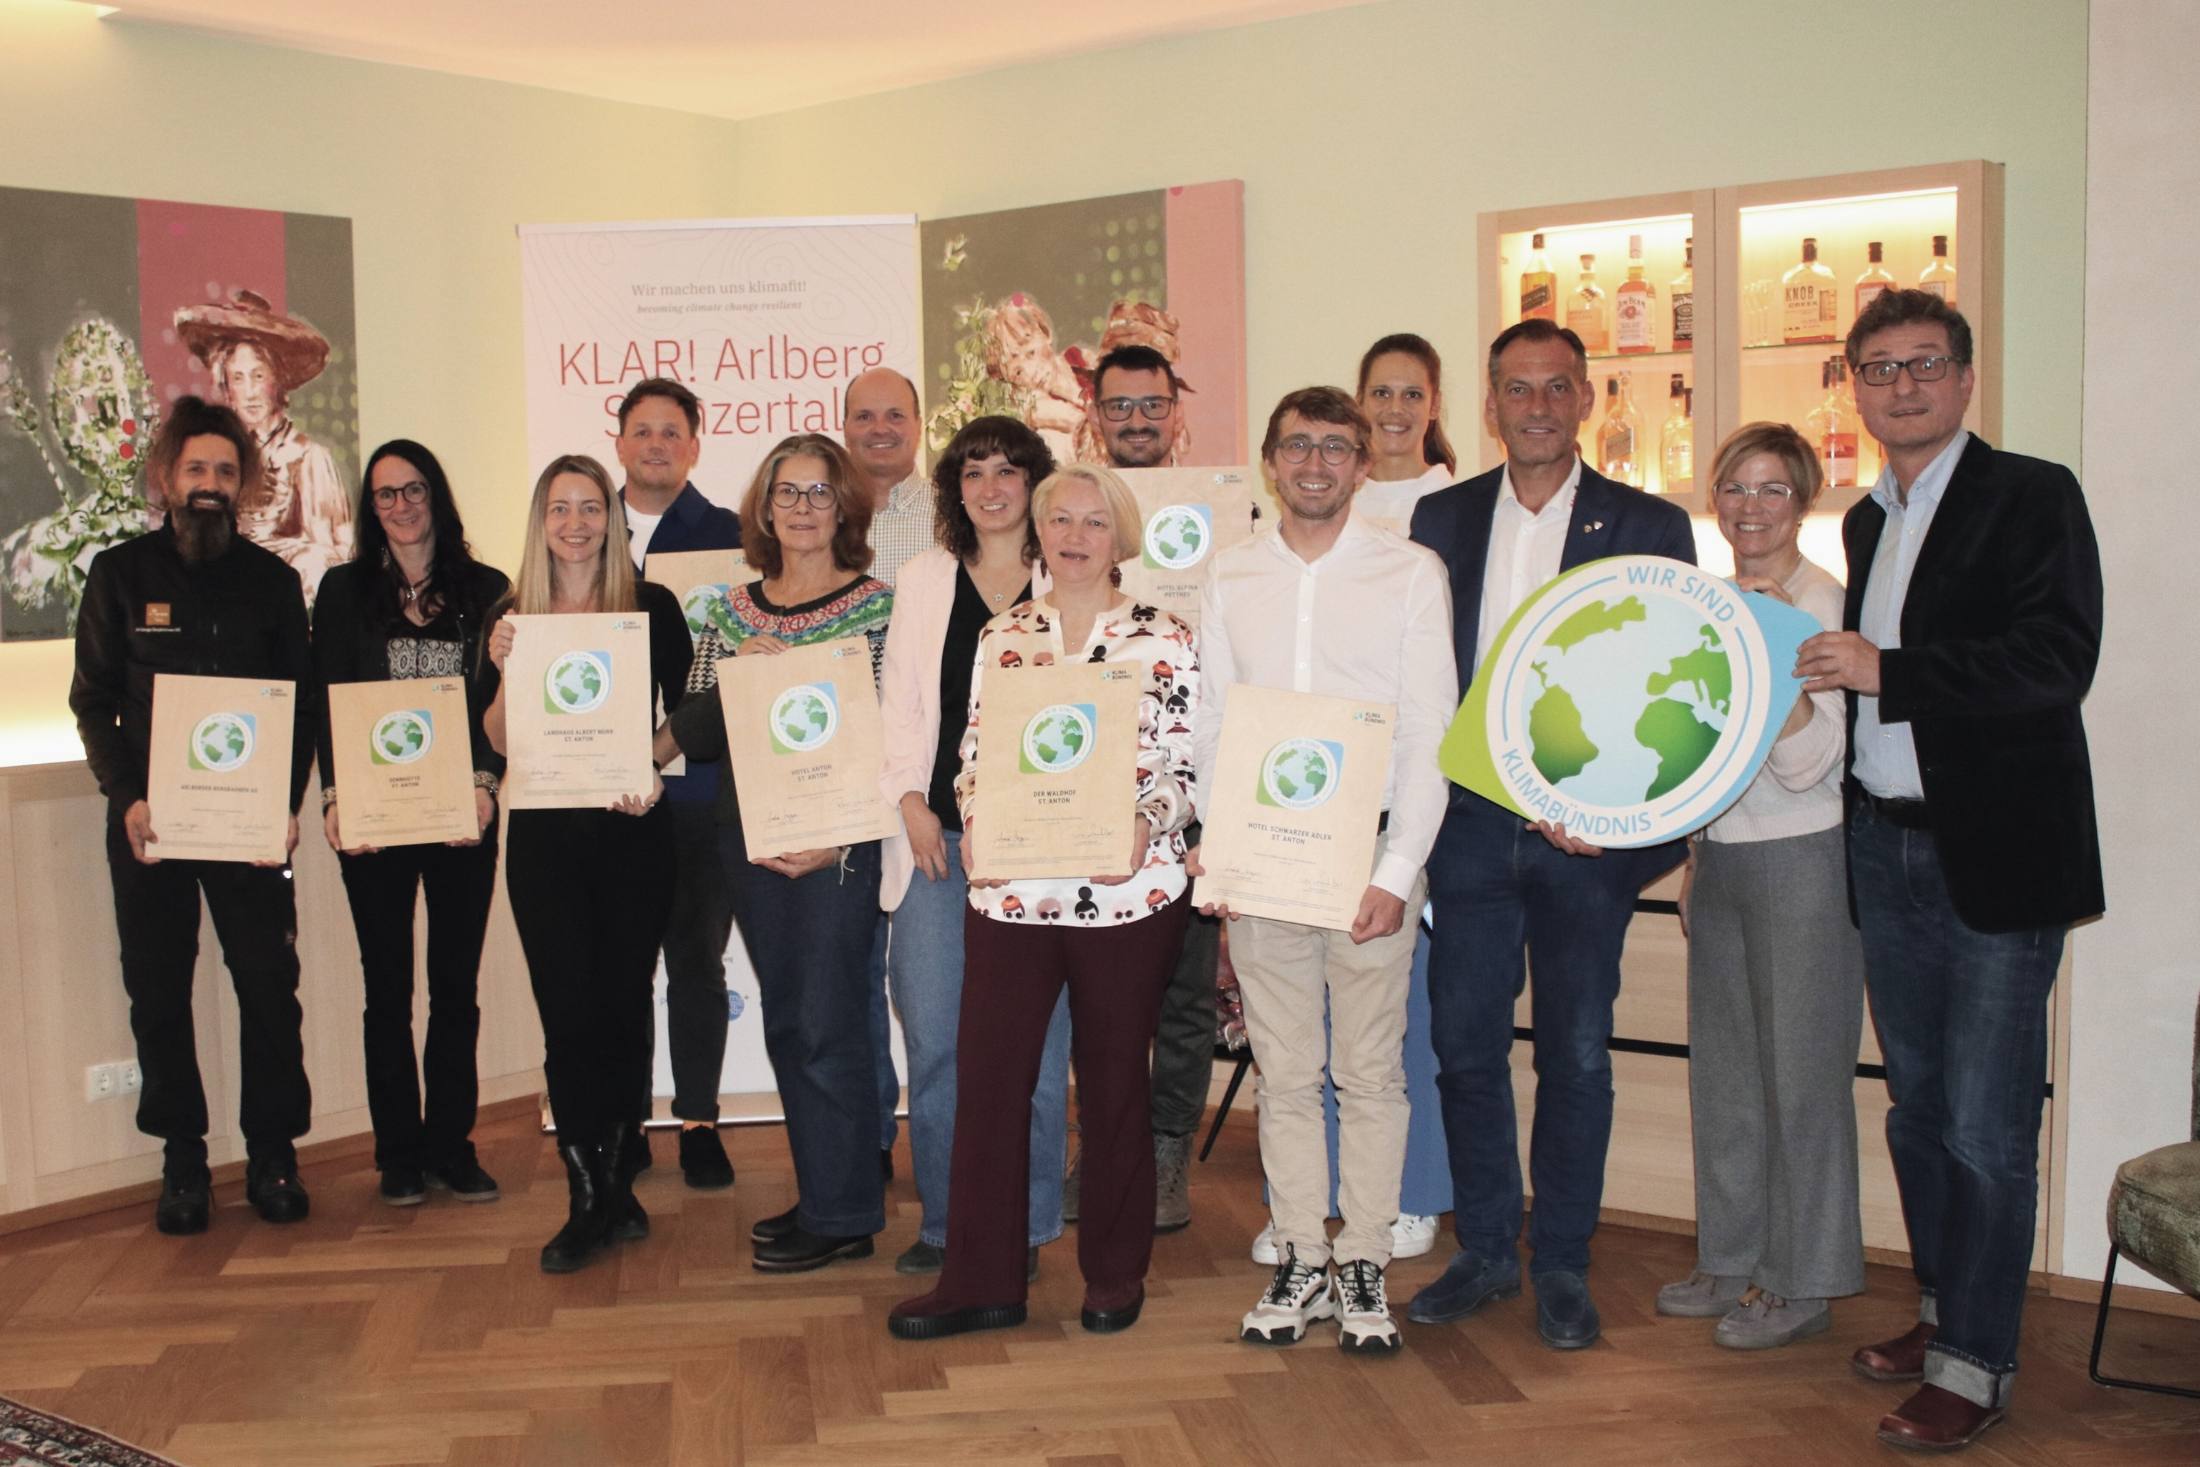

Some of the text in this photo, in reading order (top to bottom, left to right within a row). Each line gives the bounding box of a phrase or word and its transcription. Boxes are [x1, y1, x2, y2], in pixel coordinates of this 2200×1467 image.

[631, 279, 807, 297] Wir machen uns klimafit!
[1785, 285, 1814, 302] KNOB
[636, 300, 803, 315] becoming climate change resilient
[559, 334, 886, 386] KLAR! Arlberg
[604, 386, 842, 438] Snzertal
[1626, 565, 1735, 622] WIR SIND
[1046, 789, 1076, 797] WALDHOF
[1501, 748, 1652, 837] KLIMABÜNDNIS
[1248, 822, 1332, 841] HOTEL SCHWARZER ADLER
[1283, 835, 1305, 845] ANTON
